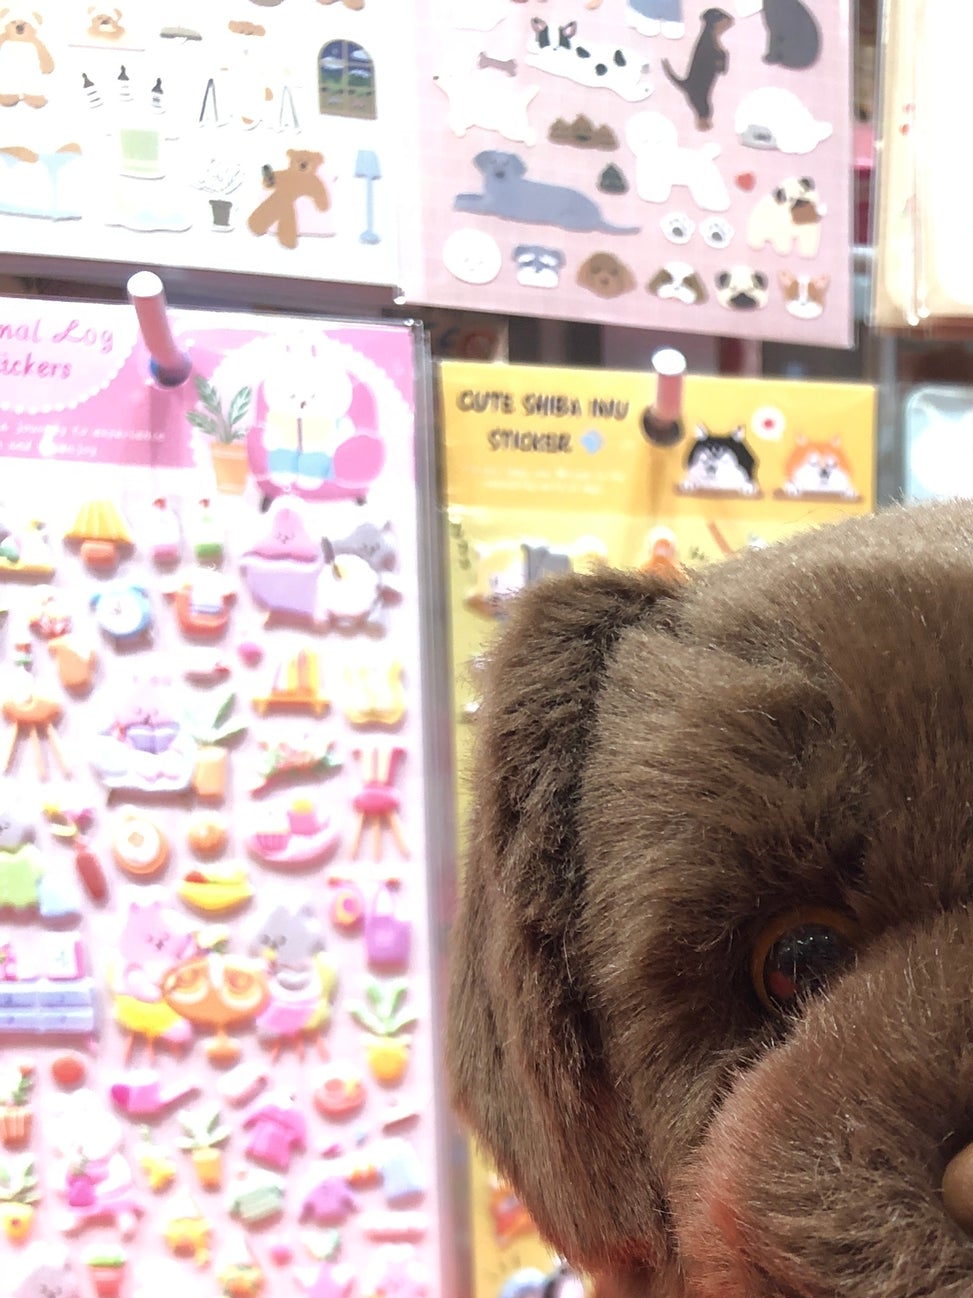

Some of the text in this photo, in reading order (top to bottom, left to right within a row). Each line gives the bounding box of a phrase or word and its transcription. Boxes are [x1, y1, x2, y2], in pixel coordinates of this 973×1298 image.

[53, 319, 114, 353] Log
[456, 390, 630, 421] CUTE SHIBA INU
[488, 428, 573, 453] STICKER
